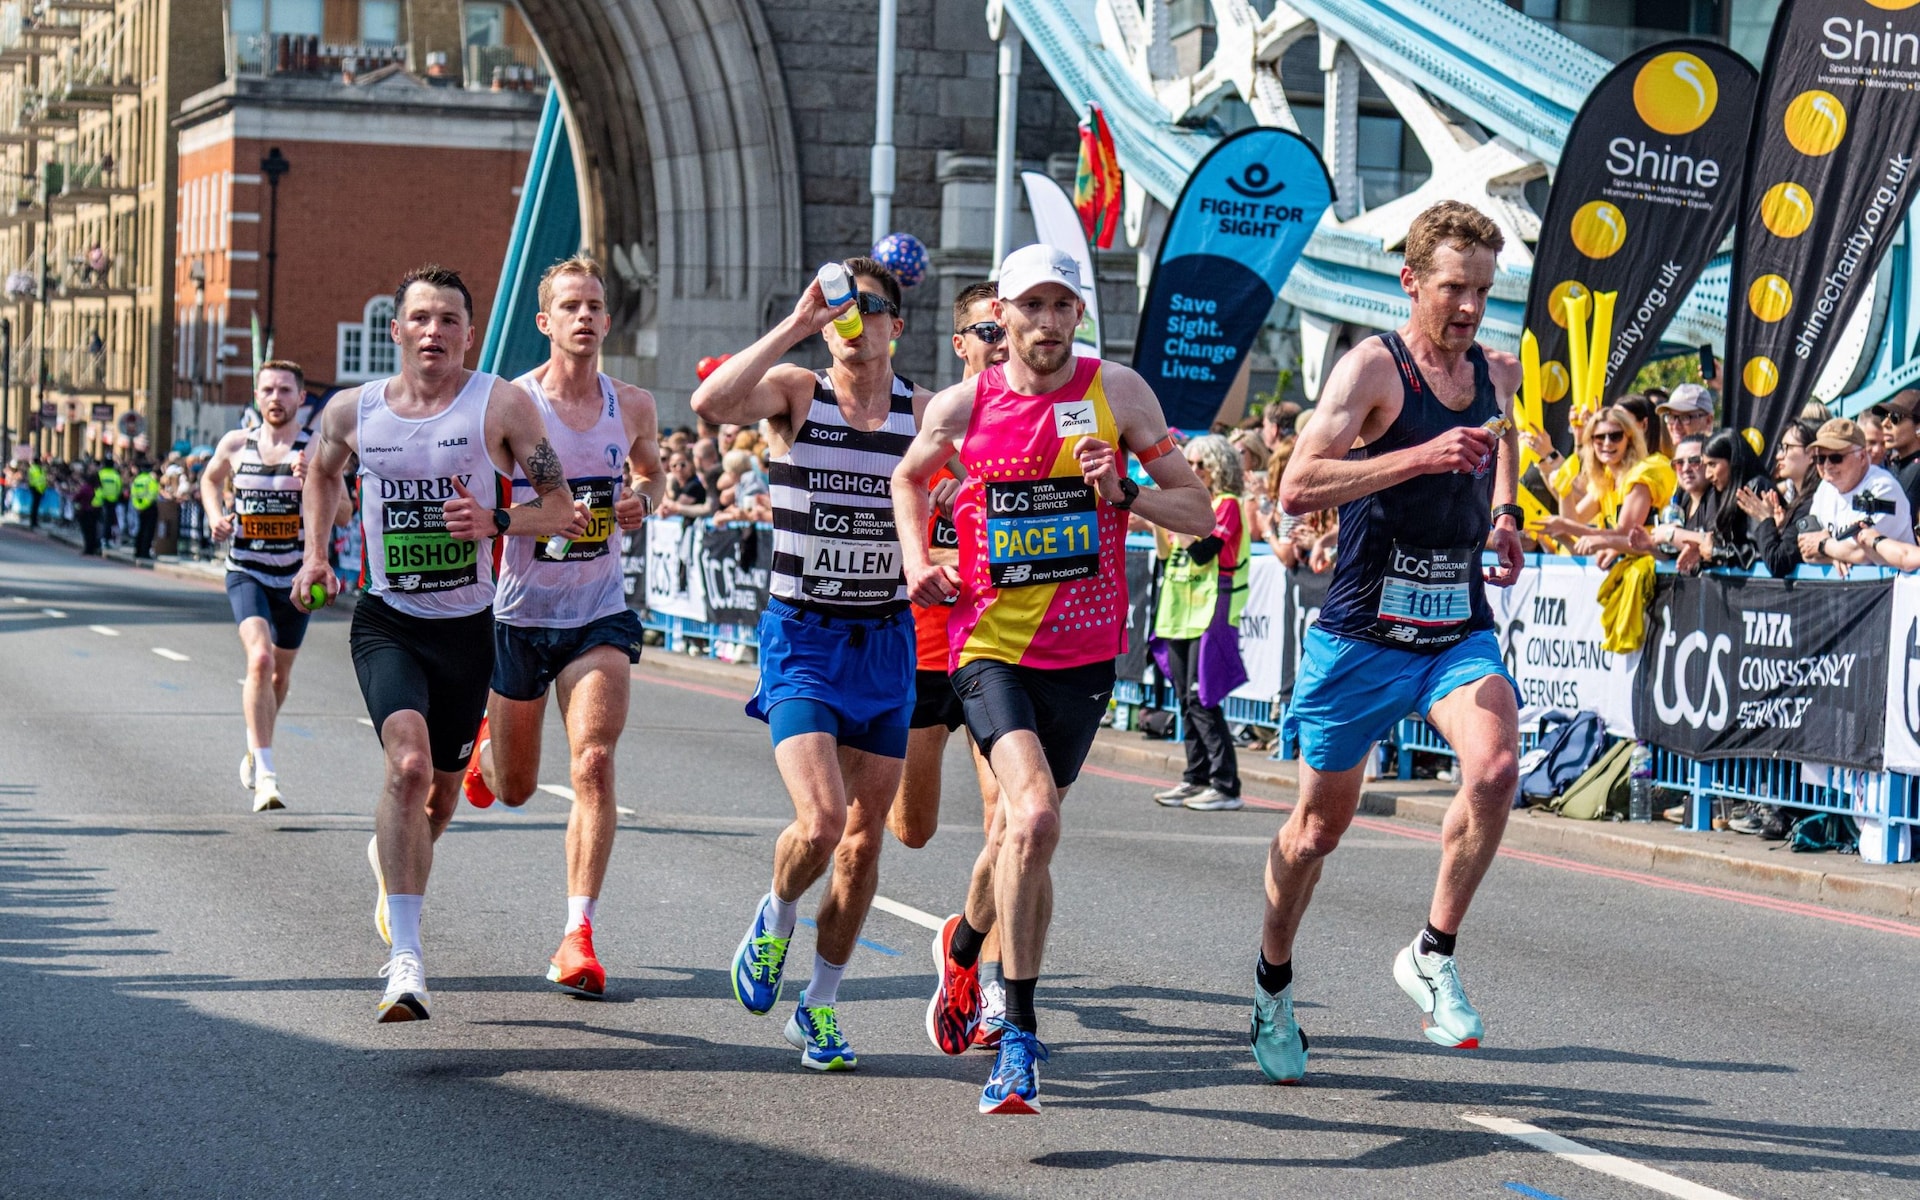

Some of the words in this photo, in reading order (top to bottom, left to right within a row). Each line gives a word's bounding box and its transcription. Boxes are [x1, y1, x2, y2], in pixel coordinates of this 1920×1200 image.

[1820, 16, 1919, 65] Shin
[1818, 75, 1858, 86] Information
[1865, 78, 1907, 91] Networking
[1879, 68, 1920, 79] Hydroceph
[1605, 137, 1719, 188] Shine
[1602, 187, 1638, 199] Information
[1644, 193, 1681, 206] Networking
[1200, 197, 1260, 218] FIGHT
[1263, 204, 1304, 223] FOR
[1219, 219, 1280, 238] SIGHT
[1796, 152, 1912, 360] shinecharity.org.uk
[1170, 293, 1217, 314] Save
[1167, 315, 1223, 340] Sight.
[1164, 338, 1237, 364] Change
[1161, 359, 1216, 382] Lives.
[438, 437, 468, 448] HUUB
[810, 427, 848, 442] soar
[808, 471, 891, 496] HIGHGA
[1032, 484, 1055, 493] TATA
[992, 488, 1030, 512] tcs
[1033, 489, 1088, 502] CONSULTANCY
[1033, 500, 1068, 511] SERVICES
[388, 507, 420, 529] tcs
[815, 508, 850, 533] tcs
[852, 519, 895, 528] CONSULTANC
[853, 512, 875, 520] TATA
[245, 521, 297, 536] LEPRETRE
[852, 527, 884, 536] SERVICES
[937, 521, 958, 544] tc
[994, 527, 1058, 558] PACE
[1062, 524, 1090, 552] 11
[388, 540, 475, 568] BISHOP
[814, 548, 893, 574] ALLEN
[1393, 549, 1430, 578] tcs
[1032, 571, 1051, 581] new
[1052, 566, 1089, 579] balance
[1429, 571, 1456, 579] SERVICES
[1431, 562, 1468, 570] CONSULTANCY
[421, 582, 438, 590] new
[440, 575, 470, 588] balance
[841, 589, 858, 598] new
[859, 589, 889, 598] balance
[1533, 596, 1567, 626] TATA
[1742, 610, 1793, 648] TATA
[1526, 636, 1614, 672] CONSULTANC
[1653, 605, 1732, 732] tcs
